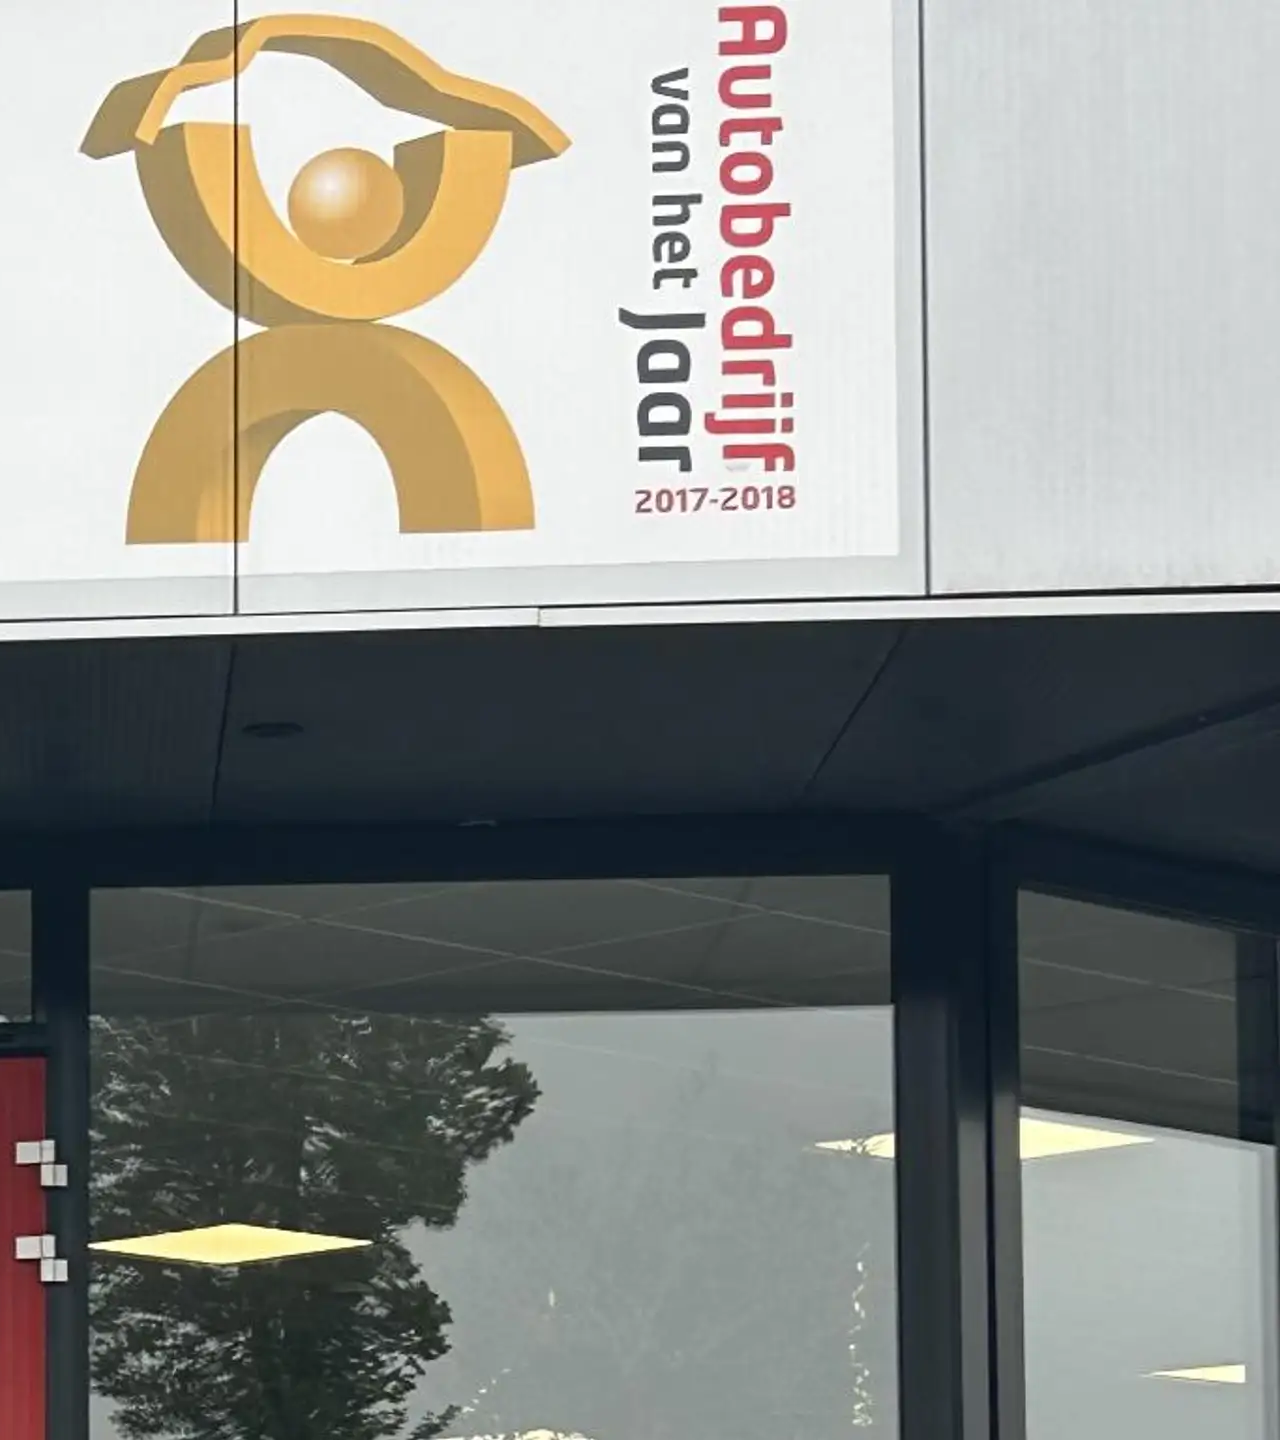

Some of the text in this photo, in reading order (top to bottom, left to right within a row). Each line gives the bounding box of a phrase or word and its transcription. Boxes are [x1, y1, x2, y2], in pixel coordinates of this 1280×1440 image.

[618, 67, 706, 473] van het Jaar
[703, 5, 796, 471] Autobedrijf
[634, 485, 796, 514] 2017-2018
